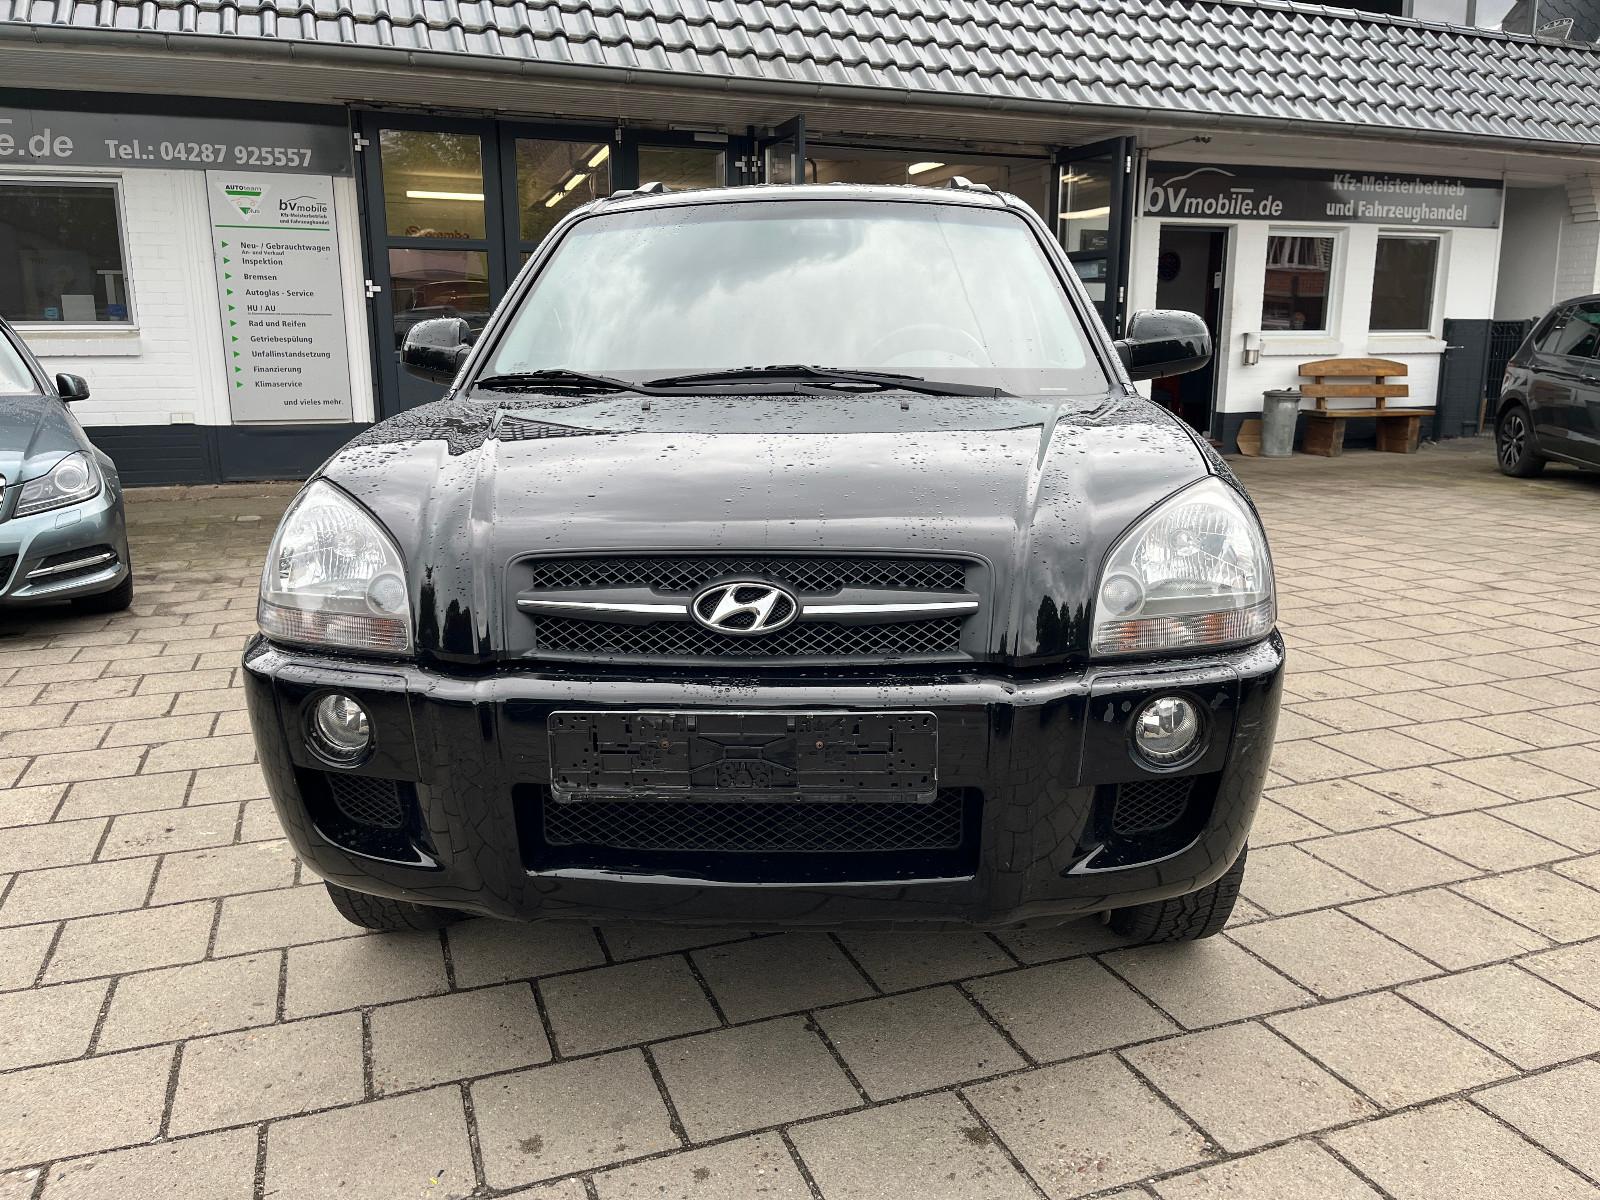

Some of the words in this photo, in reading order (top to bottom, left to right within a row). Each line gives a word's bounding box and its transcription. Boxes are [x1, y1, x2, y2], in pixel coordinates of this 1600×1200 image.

[104, 139, 154, 160] Tel.:
[160, 141, 227, 163] 04287
[234, 145, 312, 167] 925557
[1333, 173, 1466, 197] Kfz-Meisterbetrieb
[1326, 201, 1354, 216] und
[1358, 200, 1468, 223] Fahrzeughandel
[240, 241, 259, 249] Neu-
[265, 242, 331, 252] Gebrauchtwagen
[242, 257, 284, 267] Inspektion
[243, 273, 278, 281] Bremsen
[245, 288, 281, 298] Autoglas
[247, 304, 259, 312] HU
[265, 304, 277, 312] AU
[248, 320, 264, 328] Rad
[265, 320, 281, 328] und
[282, 320, 307, 328] Reifen
[250, 335, 314, 345] Getriebespülung
[251, 350, 332, 360] Unfallinstandsetzung
[253, 365, 303, 375] Finanzierung
[255, 380, 304, 388] Klimaservice
[283, 398, 299, 406] und
[299, 398, 322, 406] vieles
[322, 397, 345, 406] mehr.
